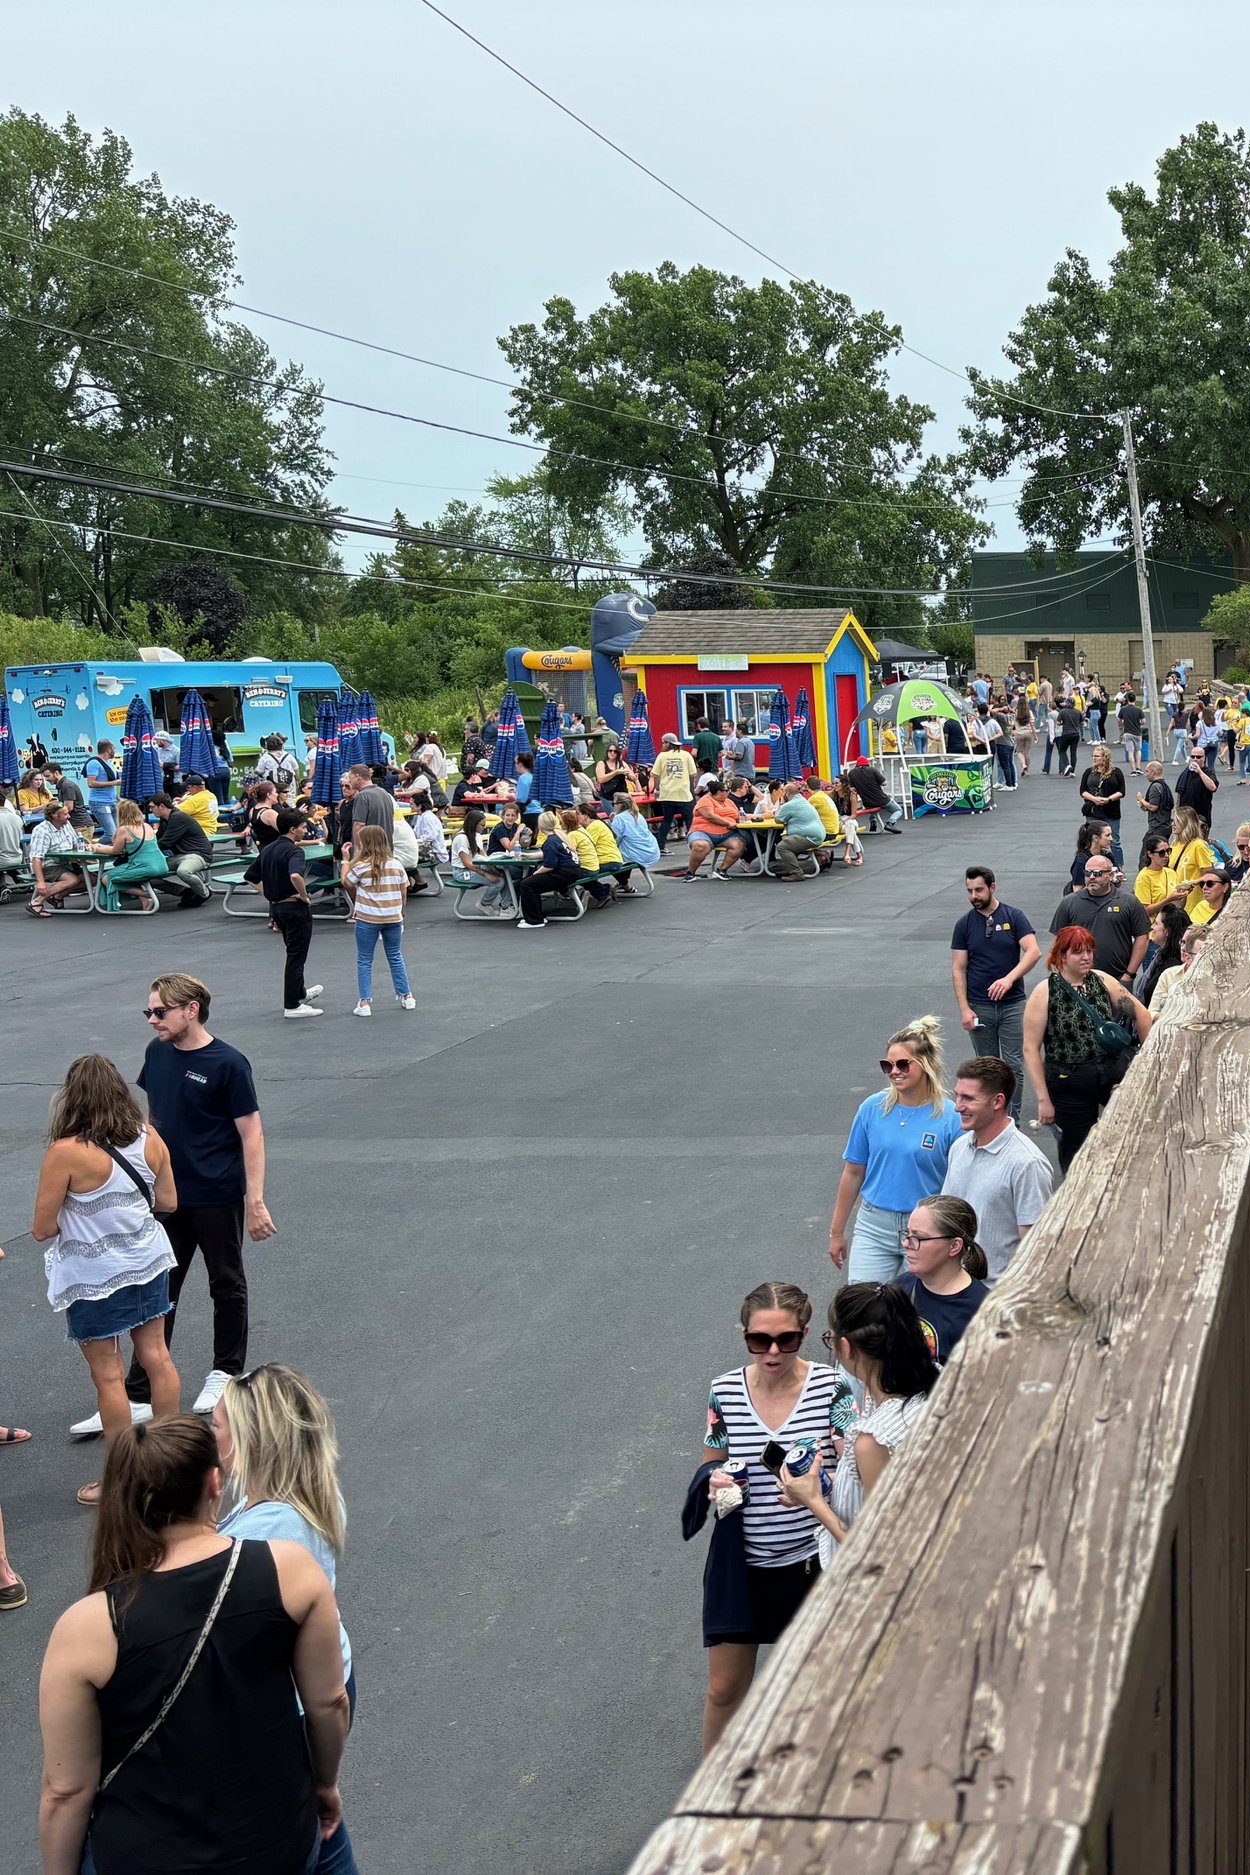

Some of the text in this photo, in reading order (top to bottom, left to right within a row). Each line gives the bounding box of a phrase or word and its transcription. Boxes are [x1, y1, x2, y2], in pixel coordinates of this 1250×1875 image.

[541, 654, 573, 669] Cougars
[38, 710, 63, 718] CATERING
[925, 788, 962, 806] Cougars
